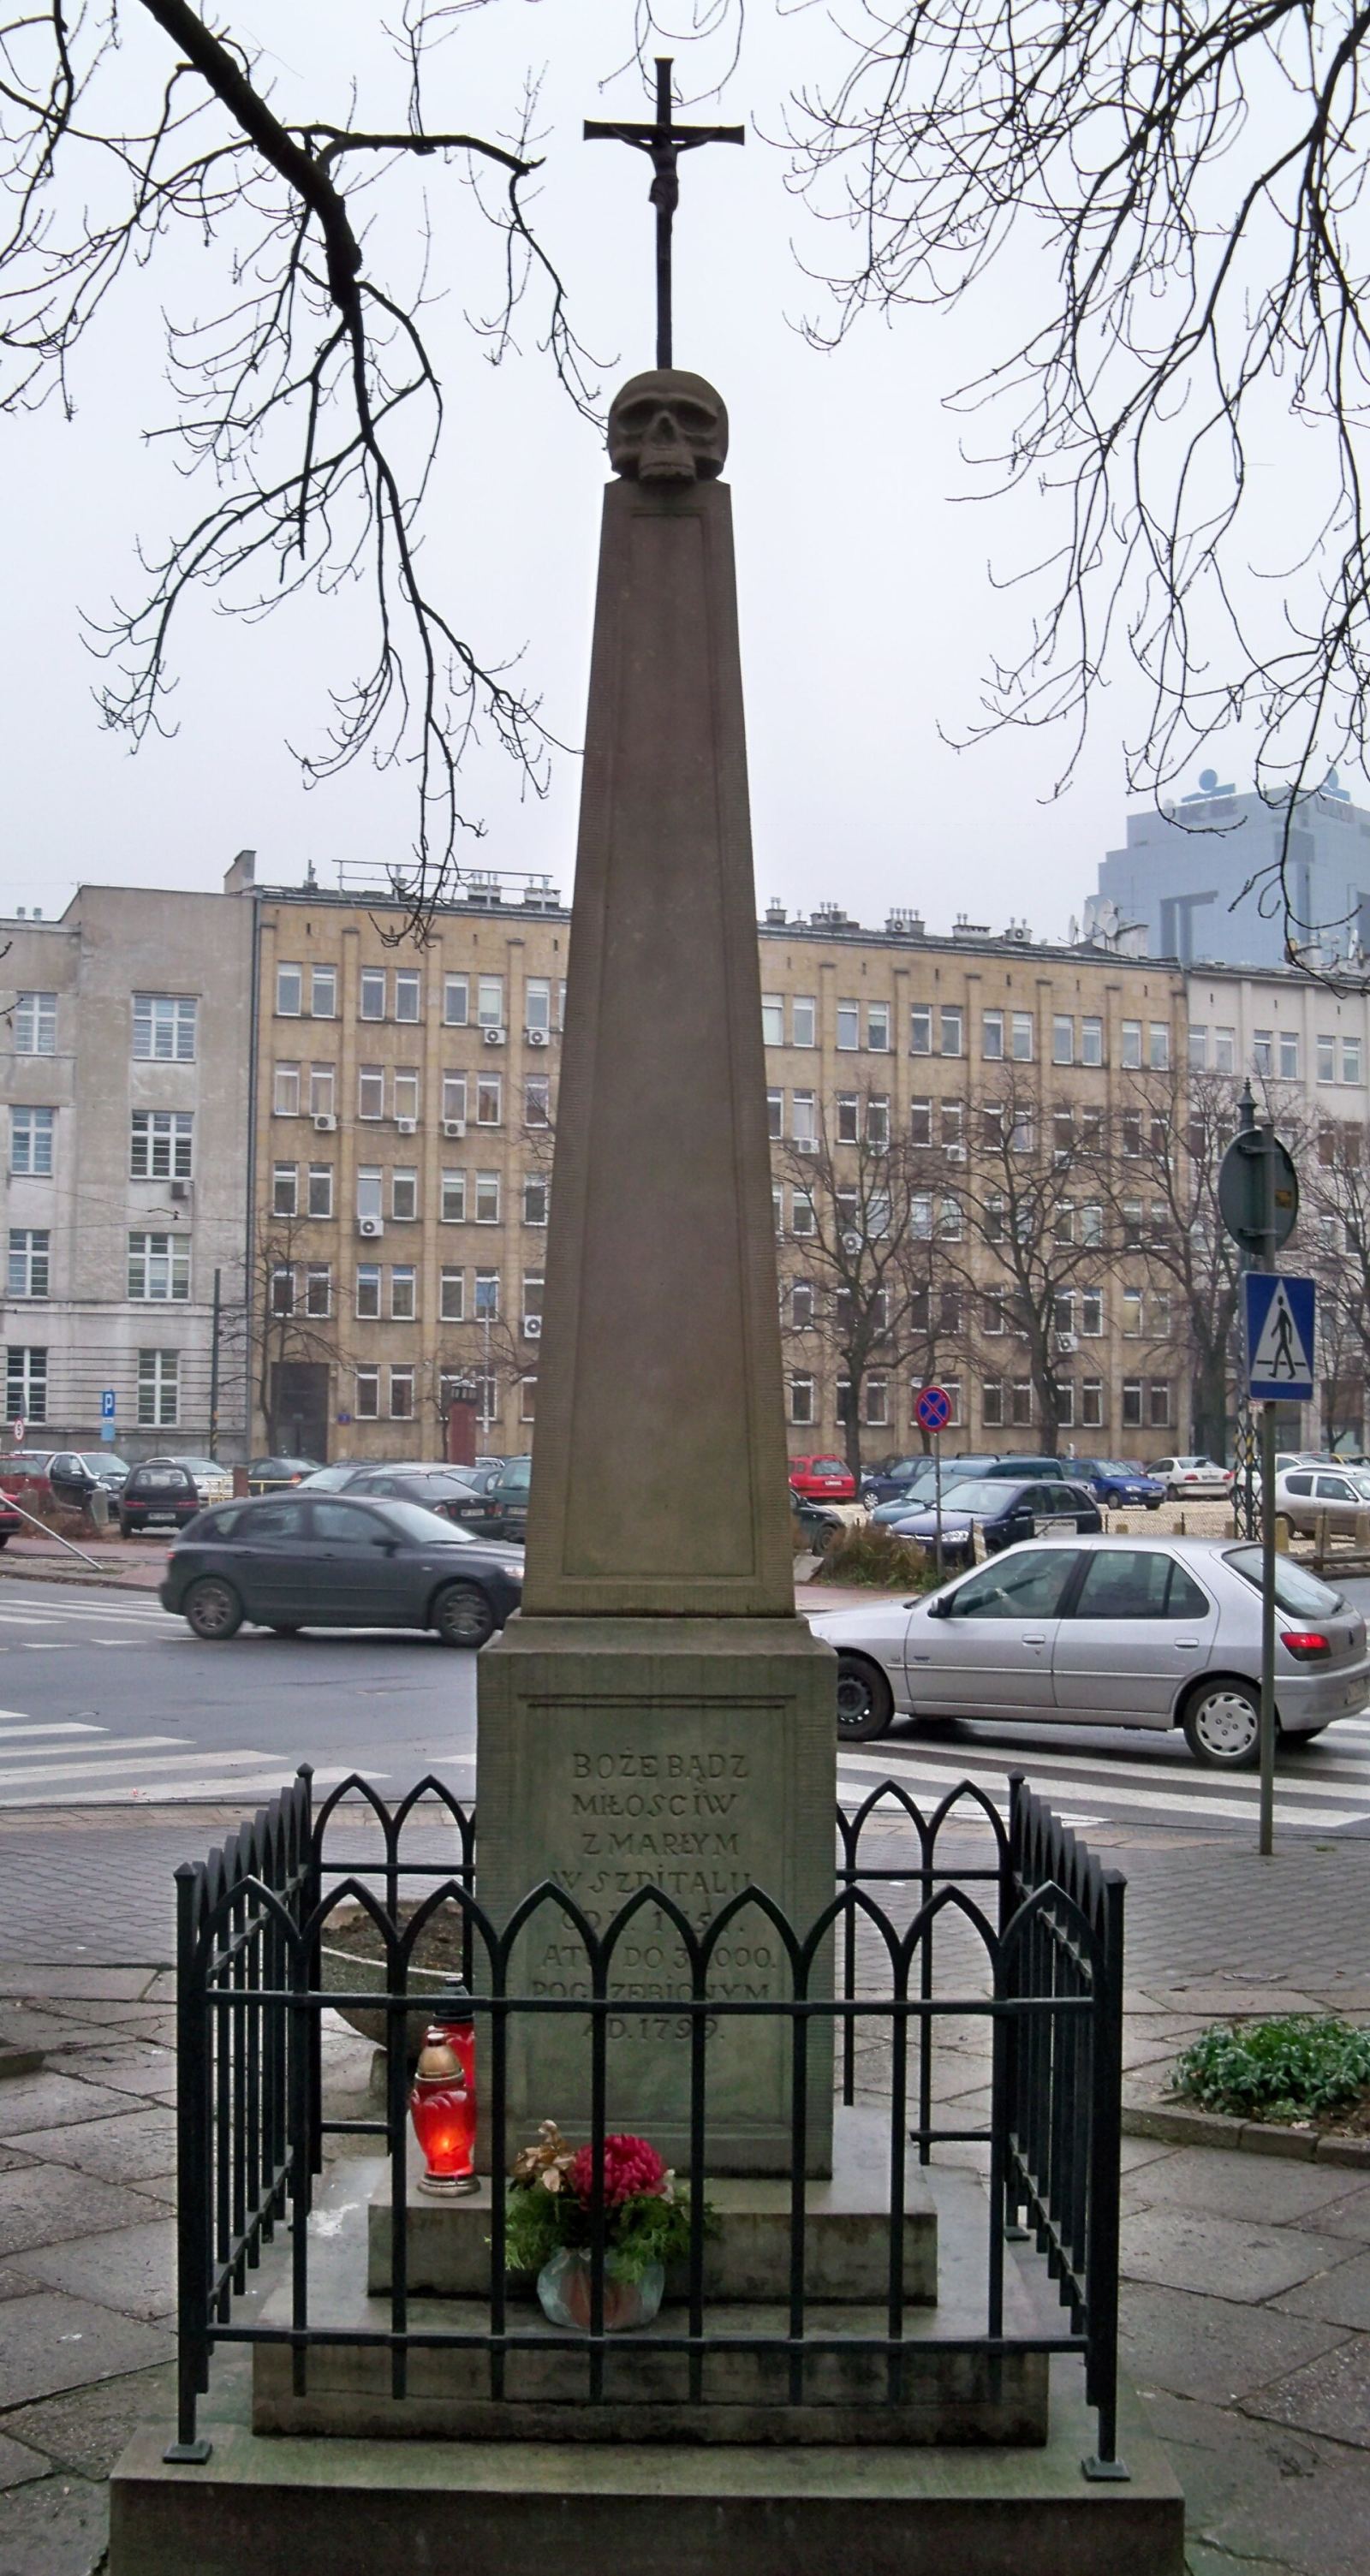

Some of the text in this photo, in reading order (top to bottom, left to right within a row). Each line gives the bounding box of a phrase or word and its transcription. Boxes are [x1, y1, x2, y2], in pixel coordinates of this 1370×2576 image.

[104, 1393, 113, 1414] P
[573, 1746, 658, 1778] BOŻE
[551, 1864, 752, 1894] W SZPITALU
[623, 1946, 664, 1968] DO
[673, 1947, 777, 1968] 3000.
